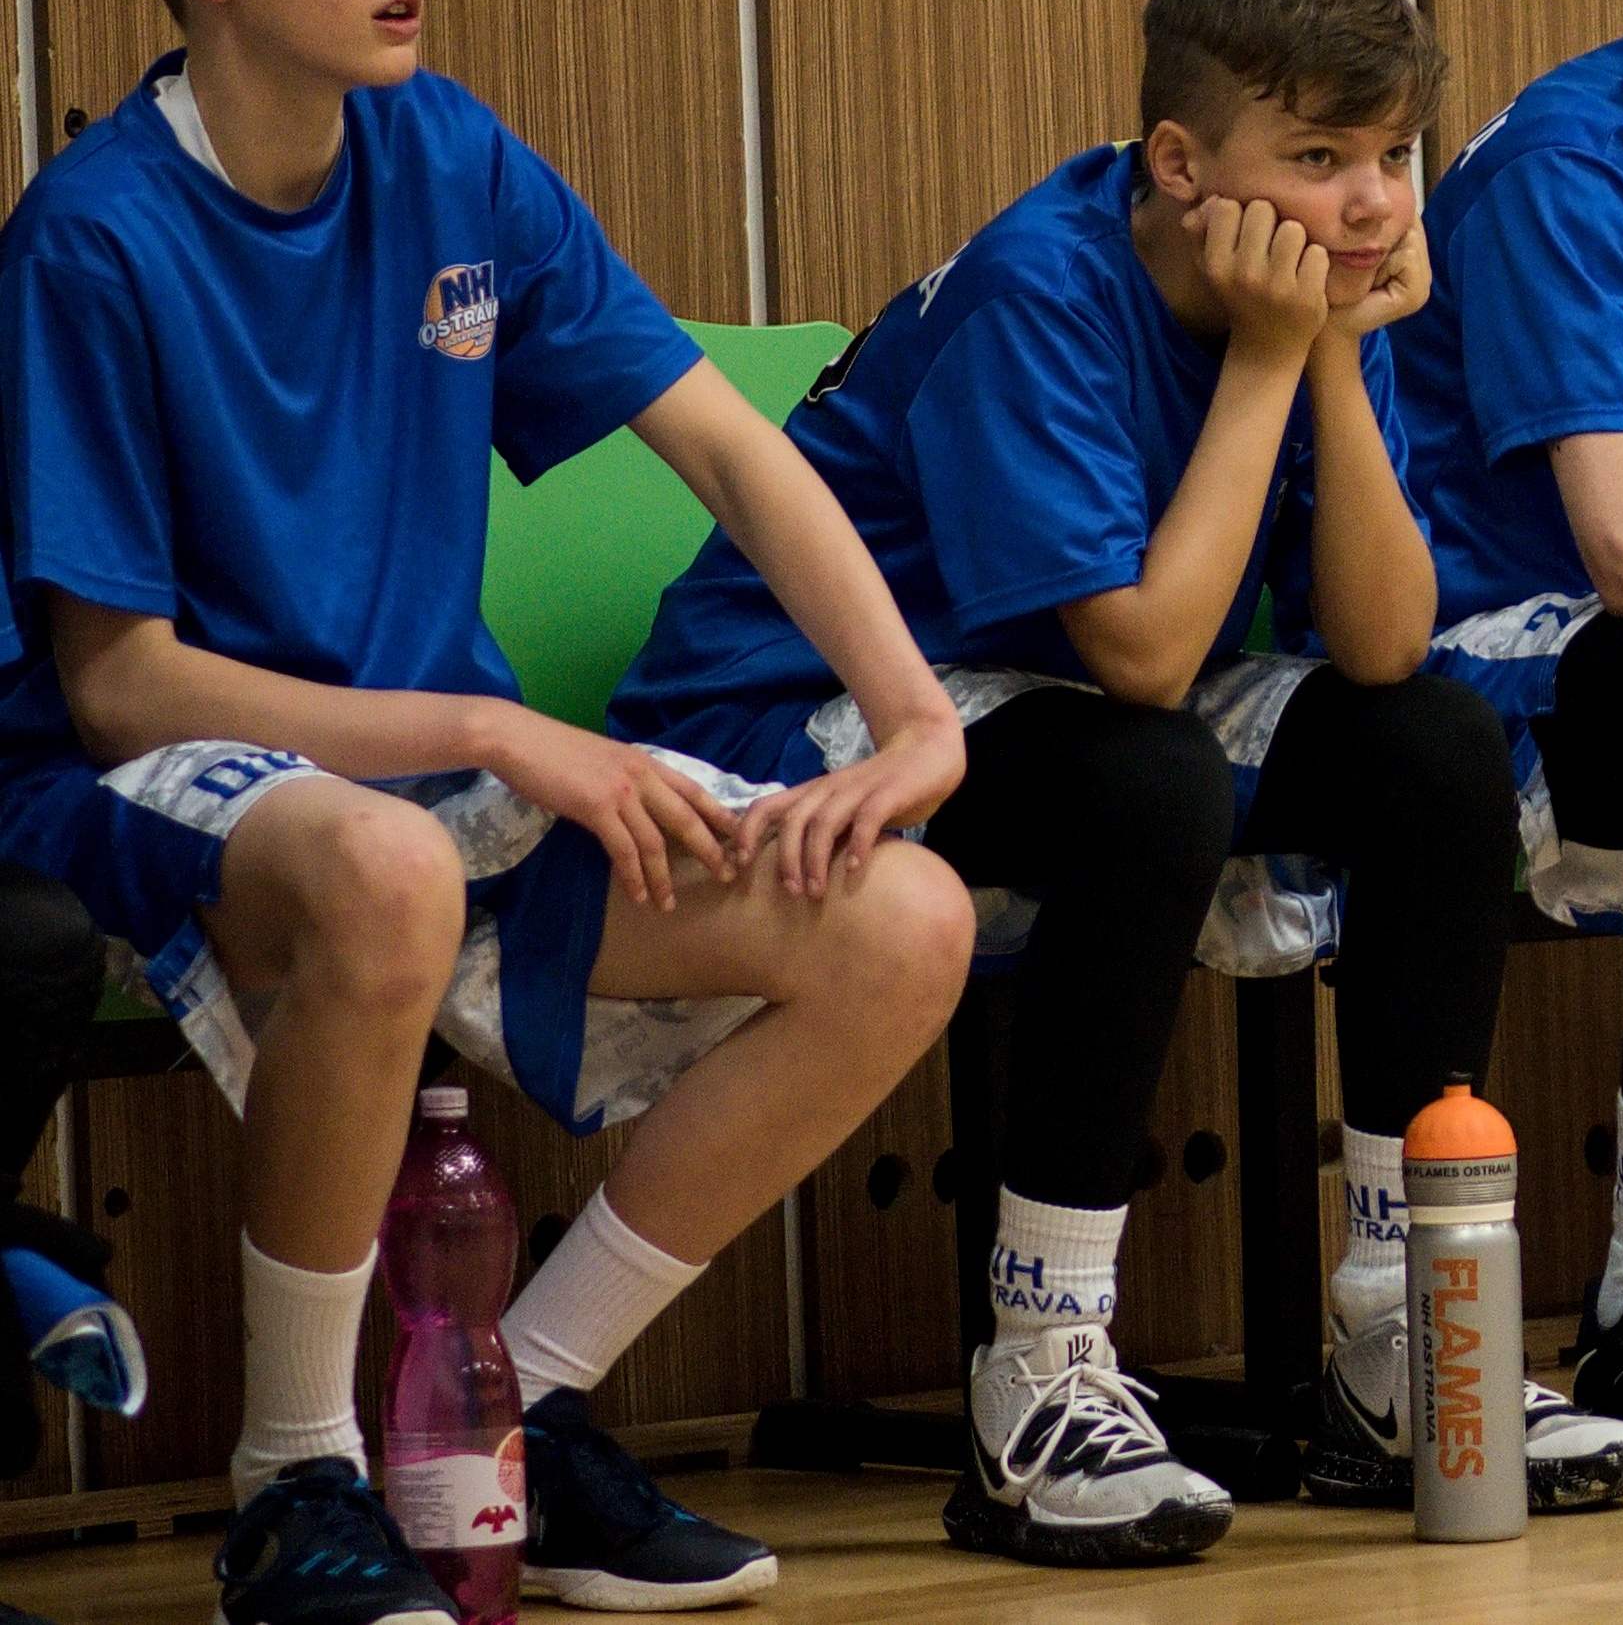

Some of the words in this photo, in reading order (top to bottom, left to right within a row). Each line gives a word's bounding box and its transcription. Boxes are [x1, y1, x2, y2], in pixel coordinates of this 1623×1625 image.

[439, 261, 494, 314] NH
[1463, 1163, 1512, 1176] OSTRAVA
[1421, 1292, 1431, 1327] NH
[1422, 1334, 1436, 1443] OSTRAVA
[1432, 1258, 1485, 1481] FLAMES
